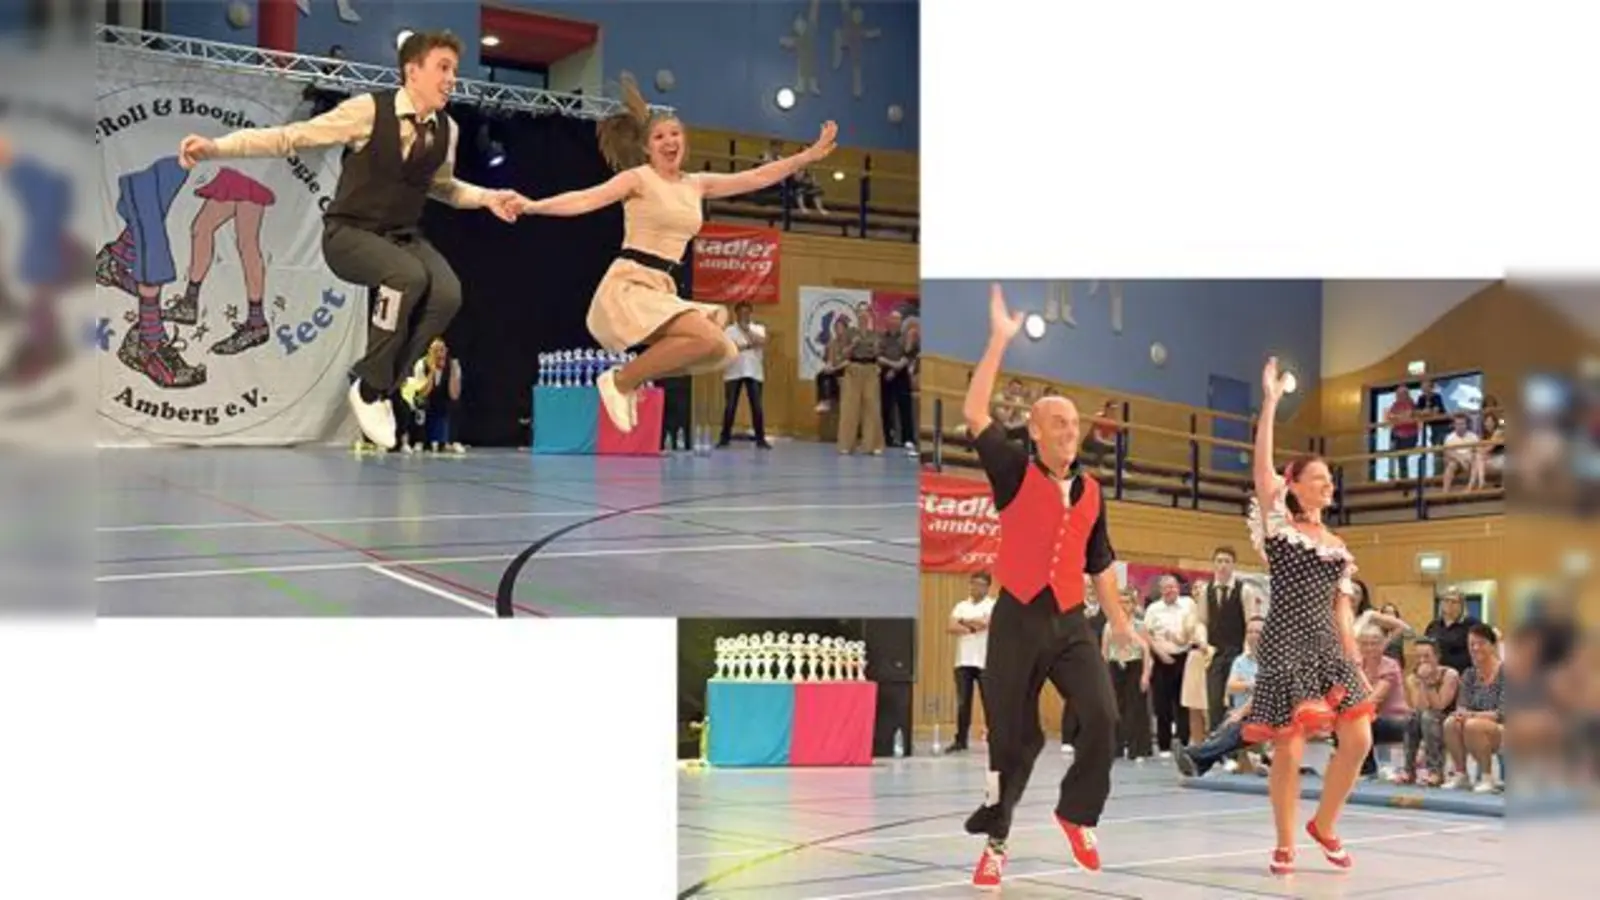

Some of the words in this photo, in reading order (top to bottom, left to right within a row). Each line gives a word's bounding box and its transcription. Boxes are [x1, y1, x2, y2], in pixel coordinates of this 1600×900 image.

[96, 103, 147, 140] Roll
[153, 98, 172, 116] &
[178, 97, 256, 129] Boogie
[287, 155, 320, 194] ogie
[694, 239, 777, 258] tadler
[276, 287, 346, 355] feet
[113, 386, 219, 426] Amberg
[927, 520, 1001, 536] amber
